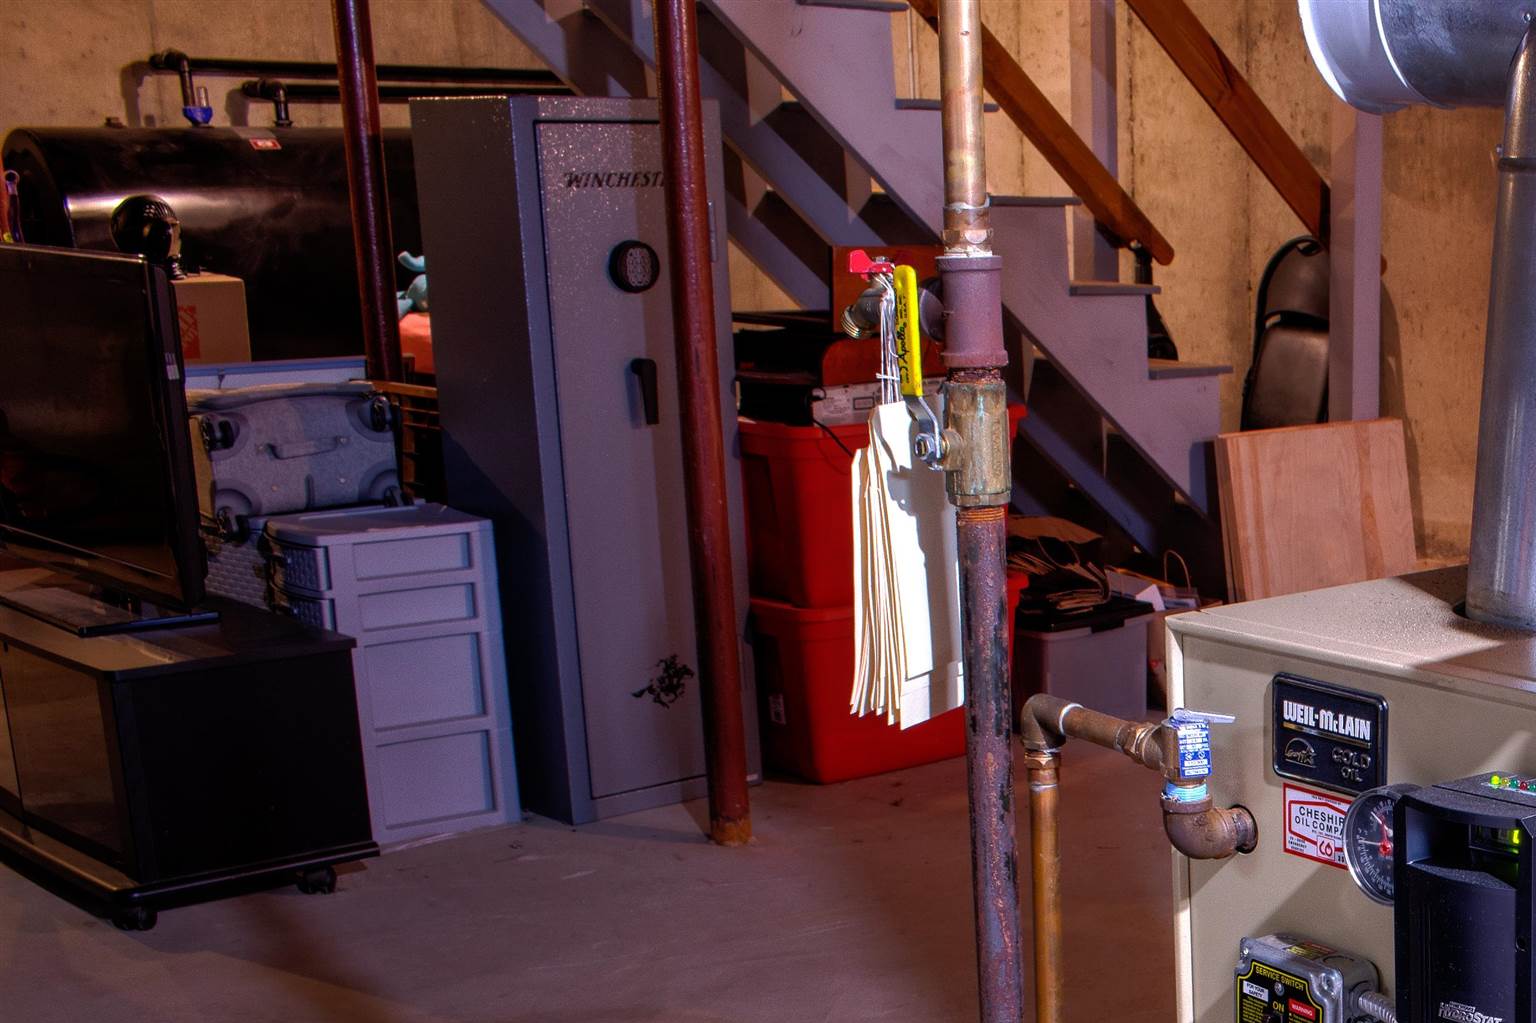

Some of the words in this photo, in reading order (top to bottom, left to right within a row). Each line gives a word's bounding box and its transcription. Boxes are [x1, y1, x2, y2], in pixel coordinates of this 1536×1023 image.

[563, 170, 664, 188] WINCHEST
[1294, 815, 1310, 828] OIL
[1298, 805, 1345, 827] CHESHIR
[1255, 965, 1280, 982] SERVICE
[1281, 974, 1305, 991] SWITCH
[1272, 1001, 1285, 1013] ON
[1291, 1003, 1314, 1016] WARNING
